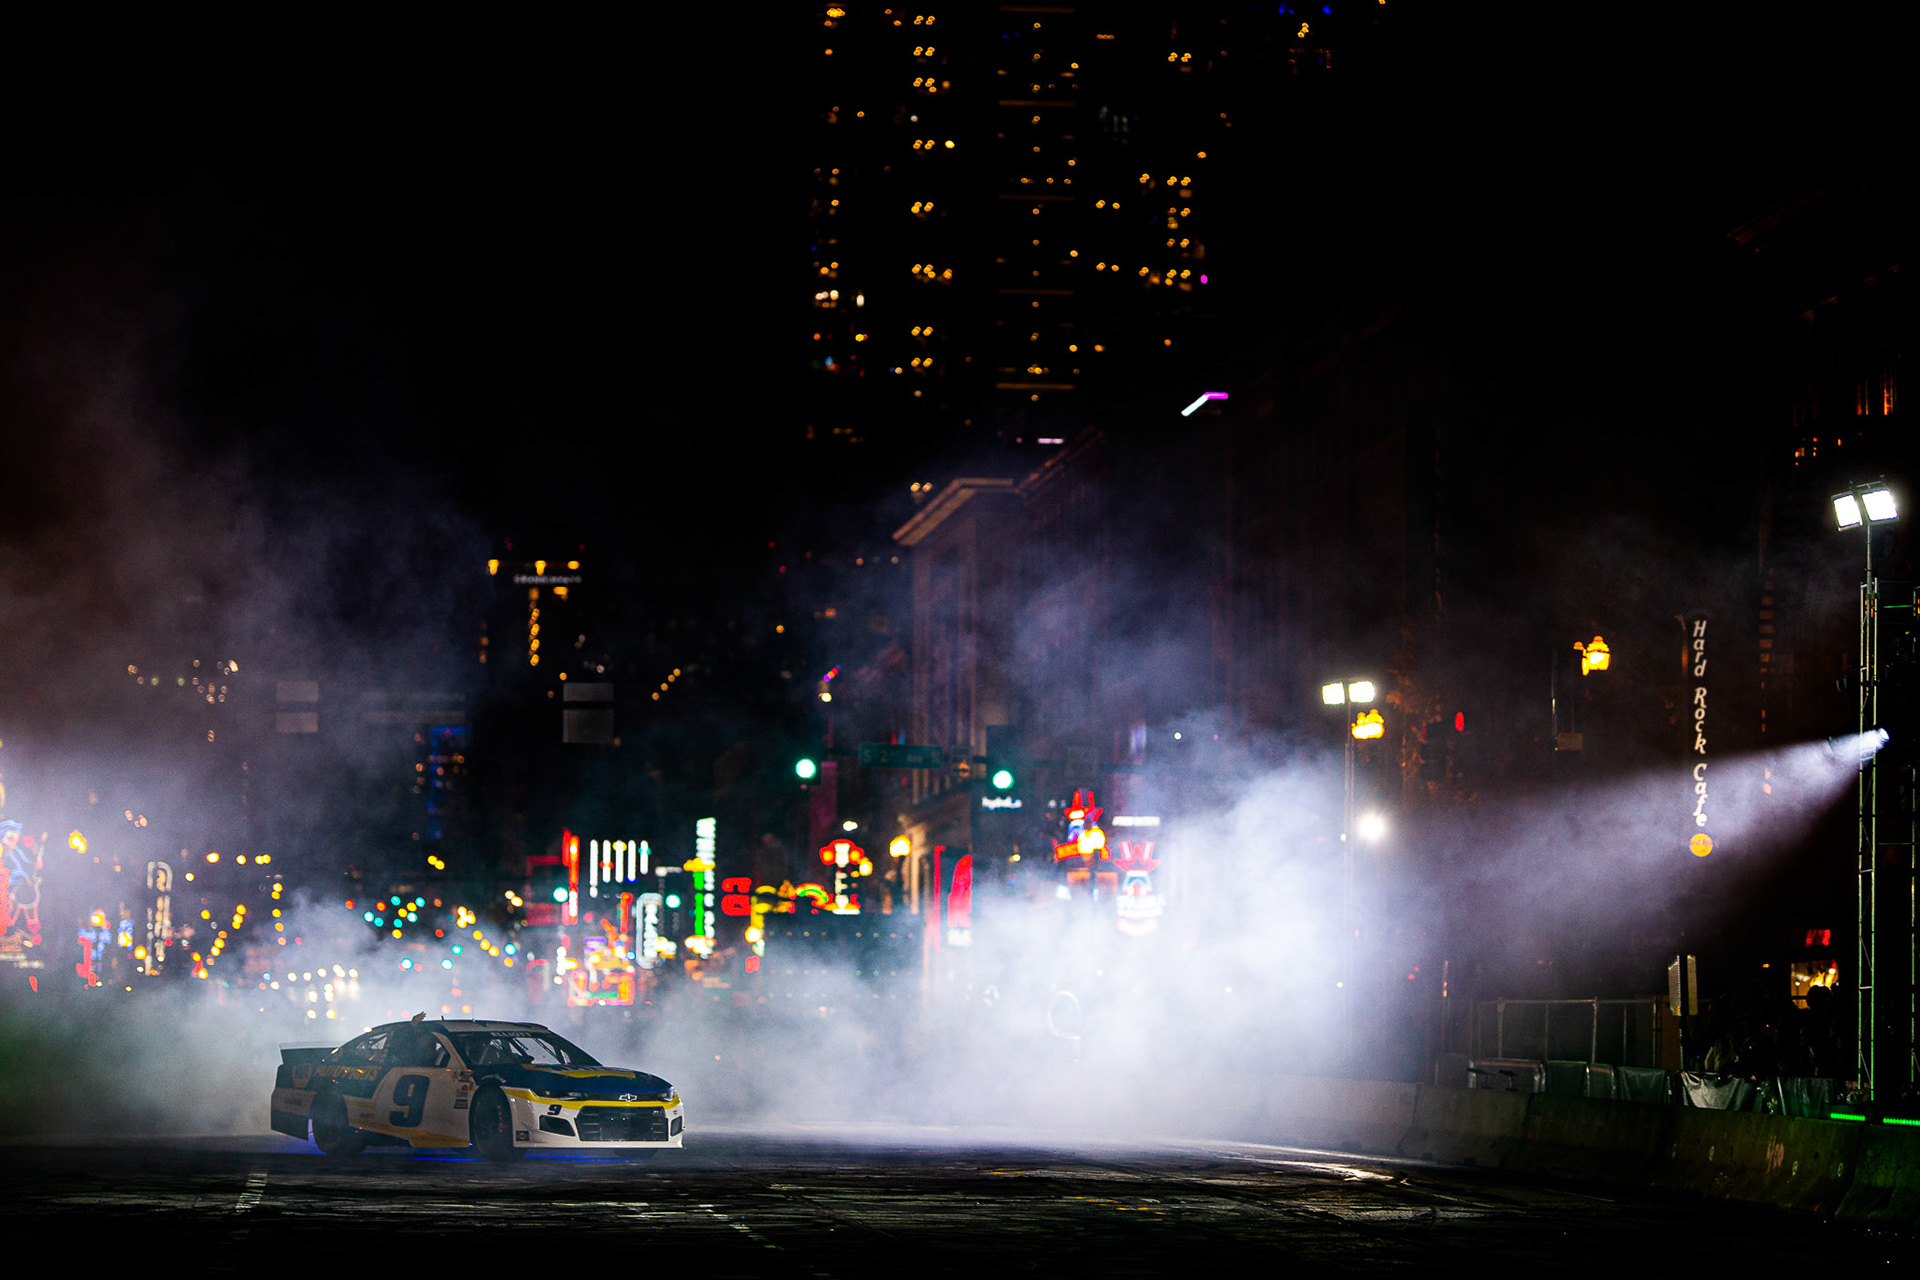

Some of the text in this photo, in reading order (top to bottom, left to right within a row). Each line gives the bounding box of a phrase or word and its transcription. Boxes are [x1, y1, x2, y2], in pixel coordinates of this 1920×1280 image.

[1692, 620, 1709, 827] Hard Rock Cafe
[389, 1074, 430, 1127] 9
[547, 1104, 562, 1116] 9
